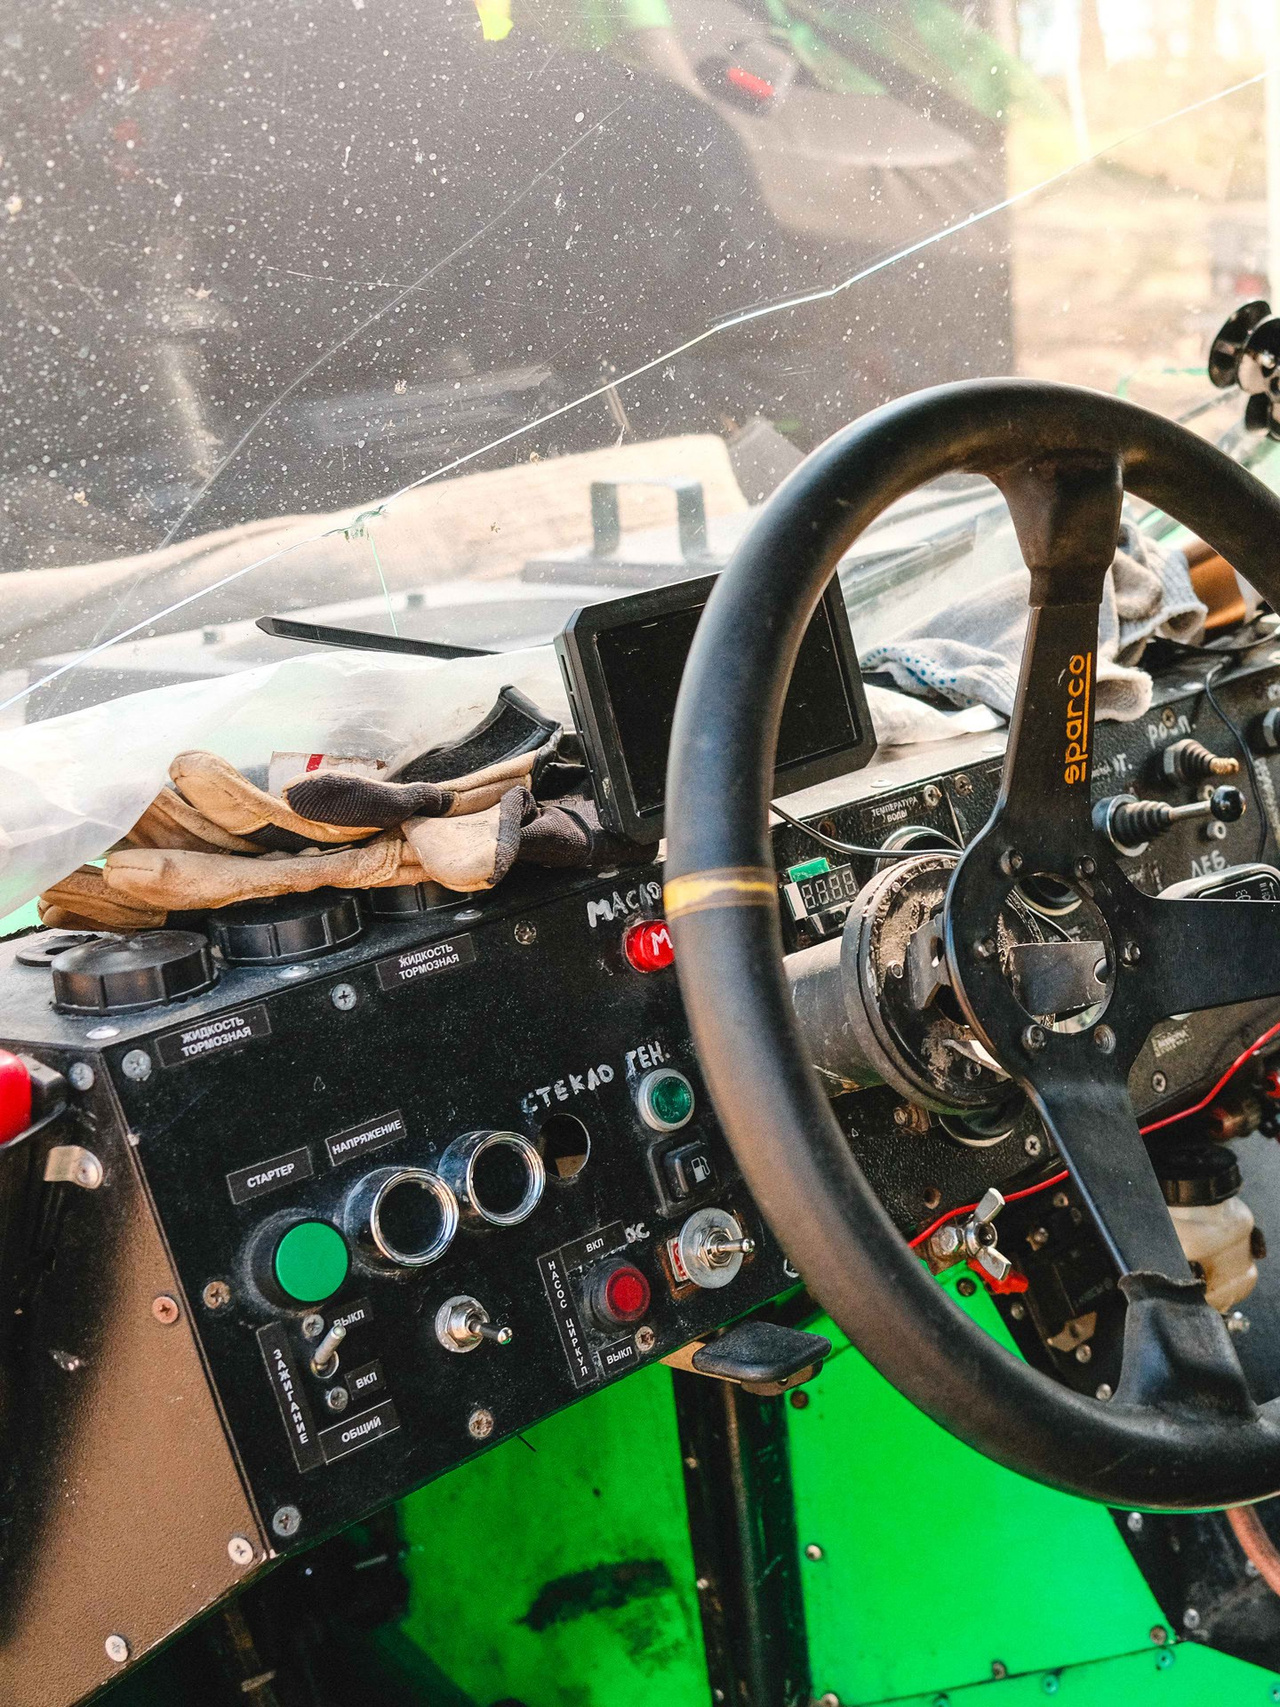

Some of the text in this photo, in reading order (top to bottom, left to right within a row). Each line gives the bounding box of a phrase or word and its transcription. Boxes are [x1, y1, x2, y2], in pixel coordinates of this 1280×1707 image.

[1064, 654, 1088, 785] sparco
[871, 796, 919, 816] ТЕМПЕРАТУРА
[886, 809, 908, 823] ВОДЫ
[398, 943, 454, 968] ЖИДКОСТЬ
[398, 953, 460, 980] ТОРМОЗНАЯ
[180, 1016, 245, 1044] ЖИДКОСТЬ
[181, 1026, 252, 1057] ТОРМОЗНАЯ
[520, 1063, 615, 1113] СТЕКЛО
[331, 1119, 403, 1155] НАПРЯЖЕНИЕ
[246, 1162, 295, 1188] СТАРТЕР
[585, 1237, 605, 1253] ВКЛ
[333, 1309, 366, 1327] ВЫКЛ
[547, 1260, 589, 1377] НАСОС ЦИРКУЛ
[606, 1345, 633, 1365] ВЫКЛ
[355, 1371, 378, 1390] ВКЛ
[272, 1348, 310, 1445] ЗАЖИГАНИЕ
[341, 1415, 383, 1443] ОБЩИЙ
